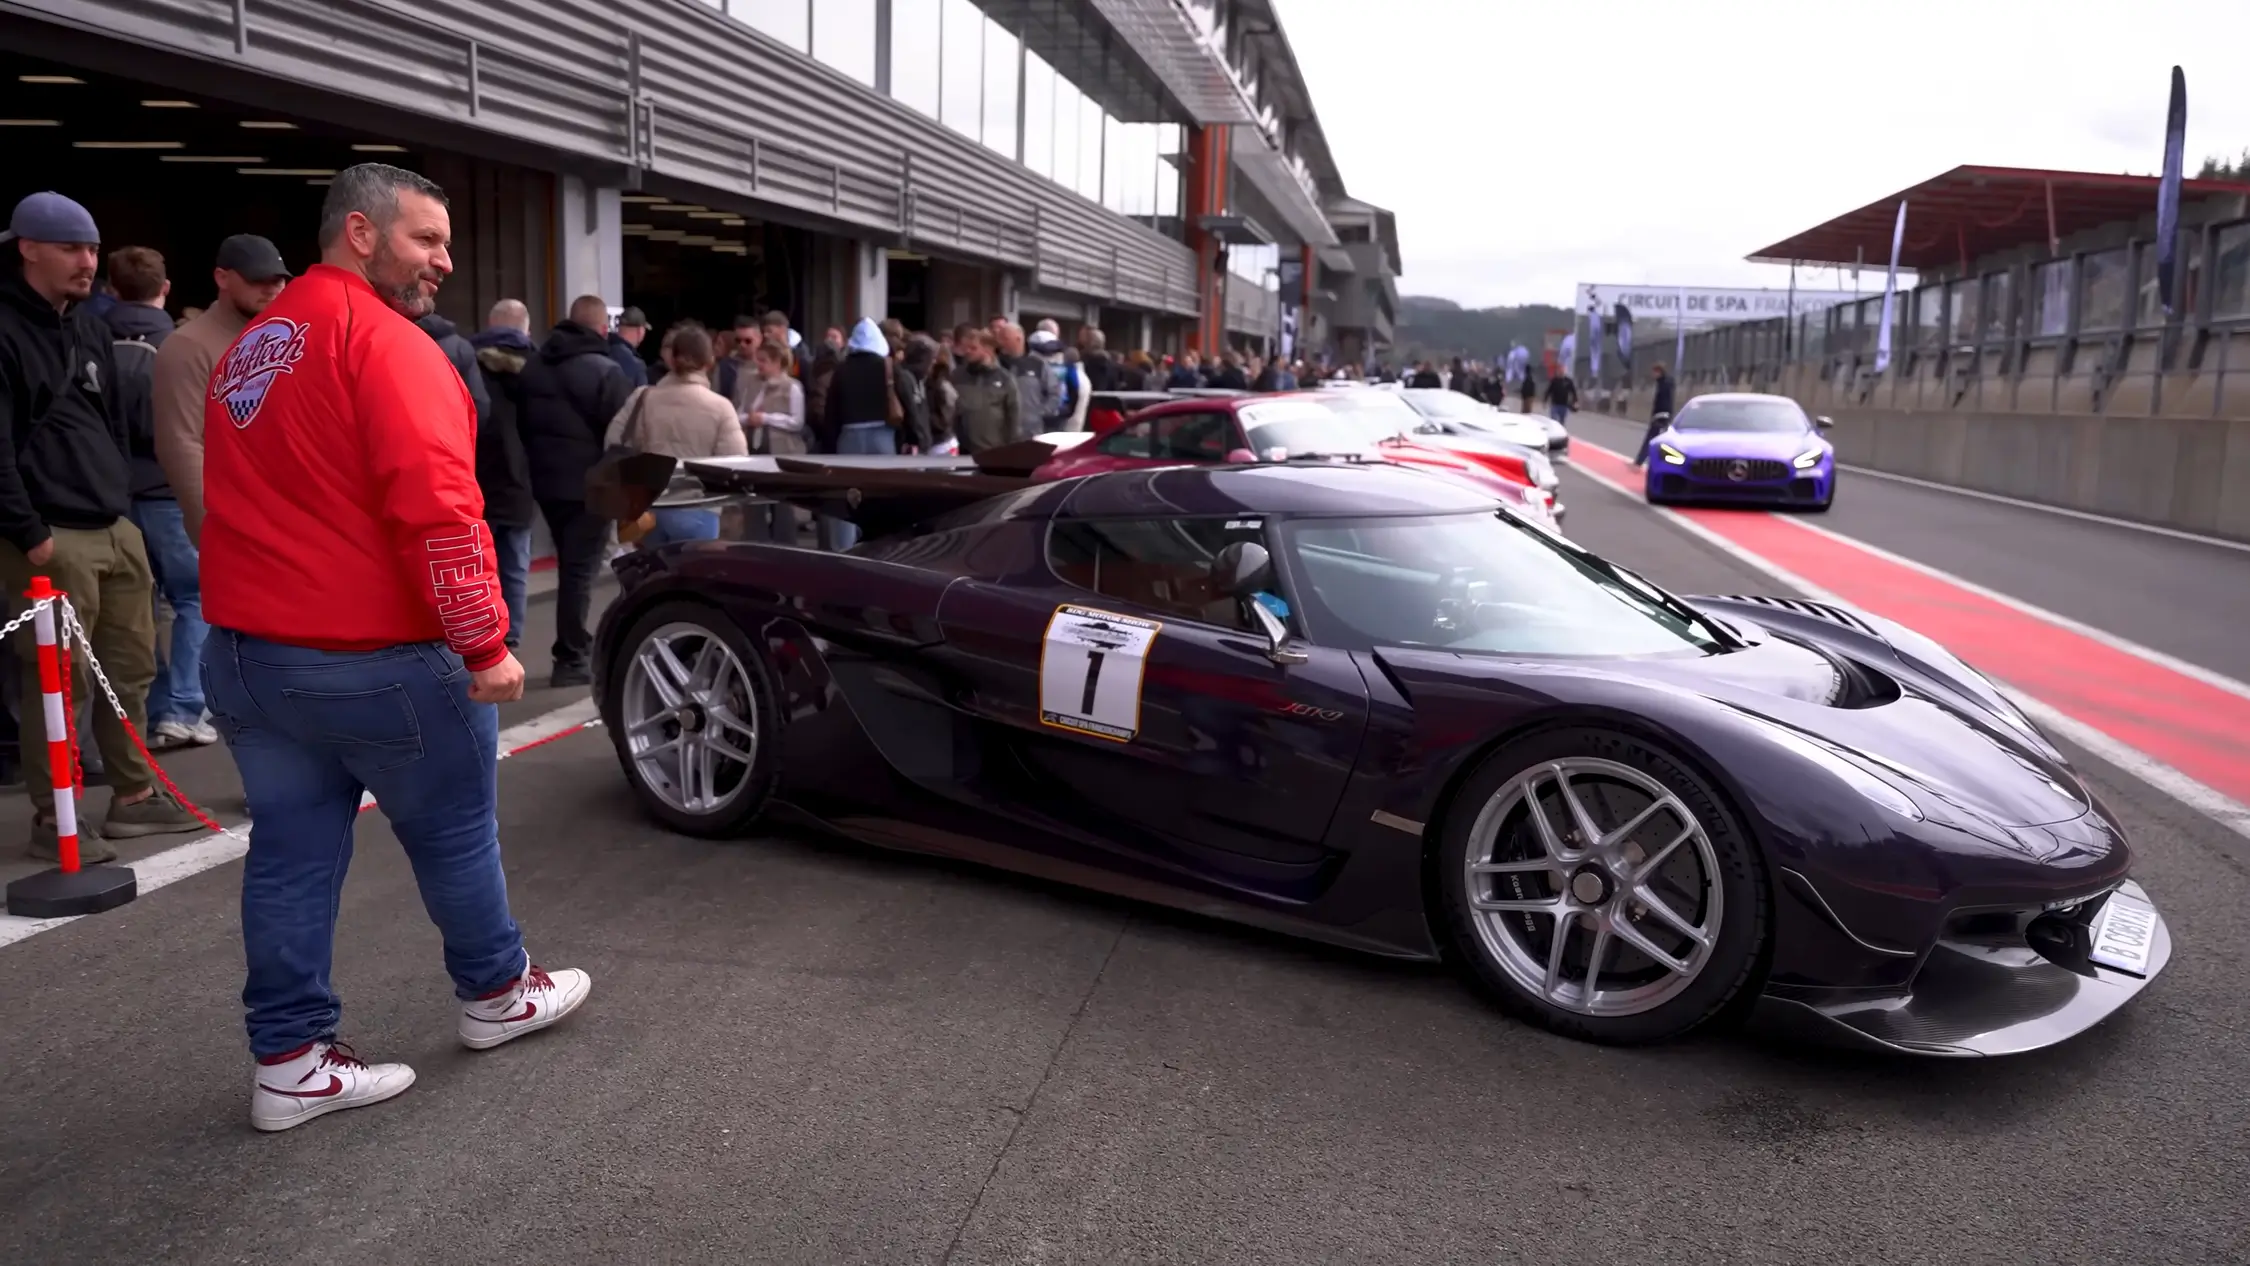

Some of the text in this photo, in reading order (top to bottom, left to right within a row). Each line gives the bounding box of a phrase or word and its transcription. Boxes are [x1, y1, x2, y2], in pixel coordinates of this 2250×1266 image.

[1619, 293, 1680, 311] CIRCUIT
[1687, 295, 1708, 312] DE
[1715, 295, 1747, 312] SPA
[211, 322, 310, 400] Shiftech
[426, 523, 500, 651] TEAM
[1081, 650, 1105, 716] 1
[2100, 945, 2141, 960] B
